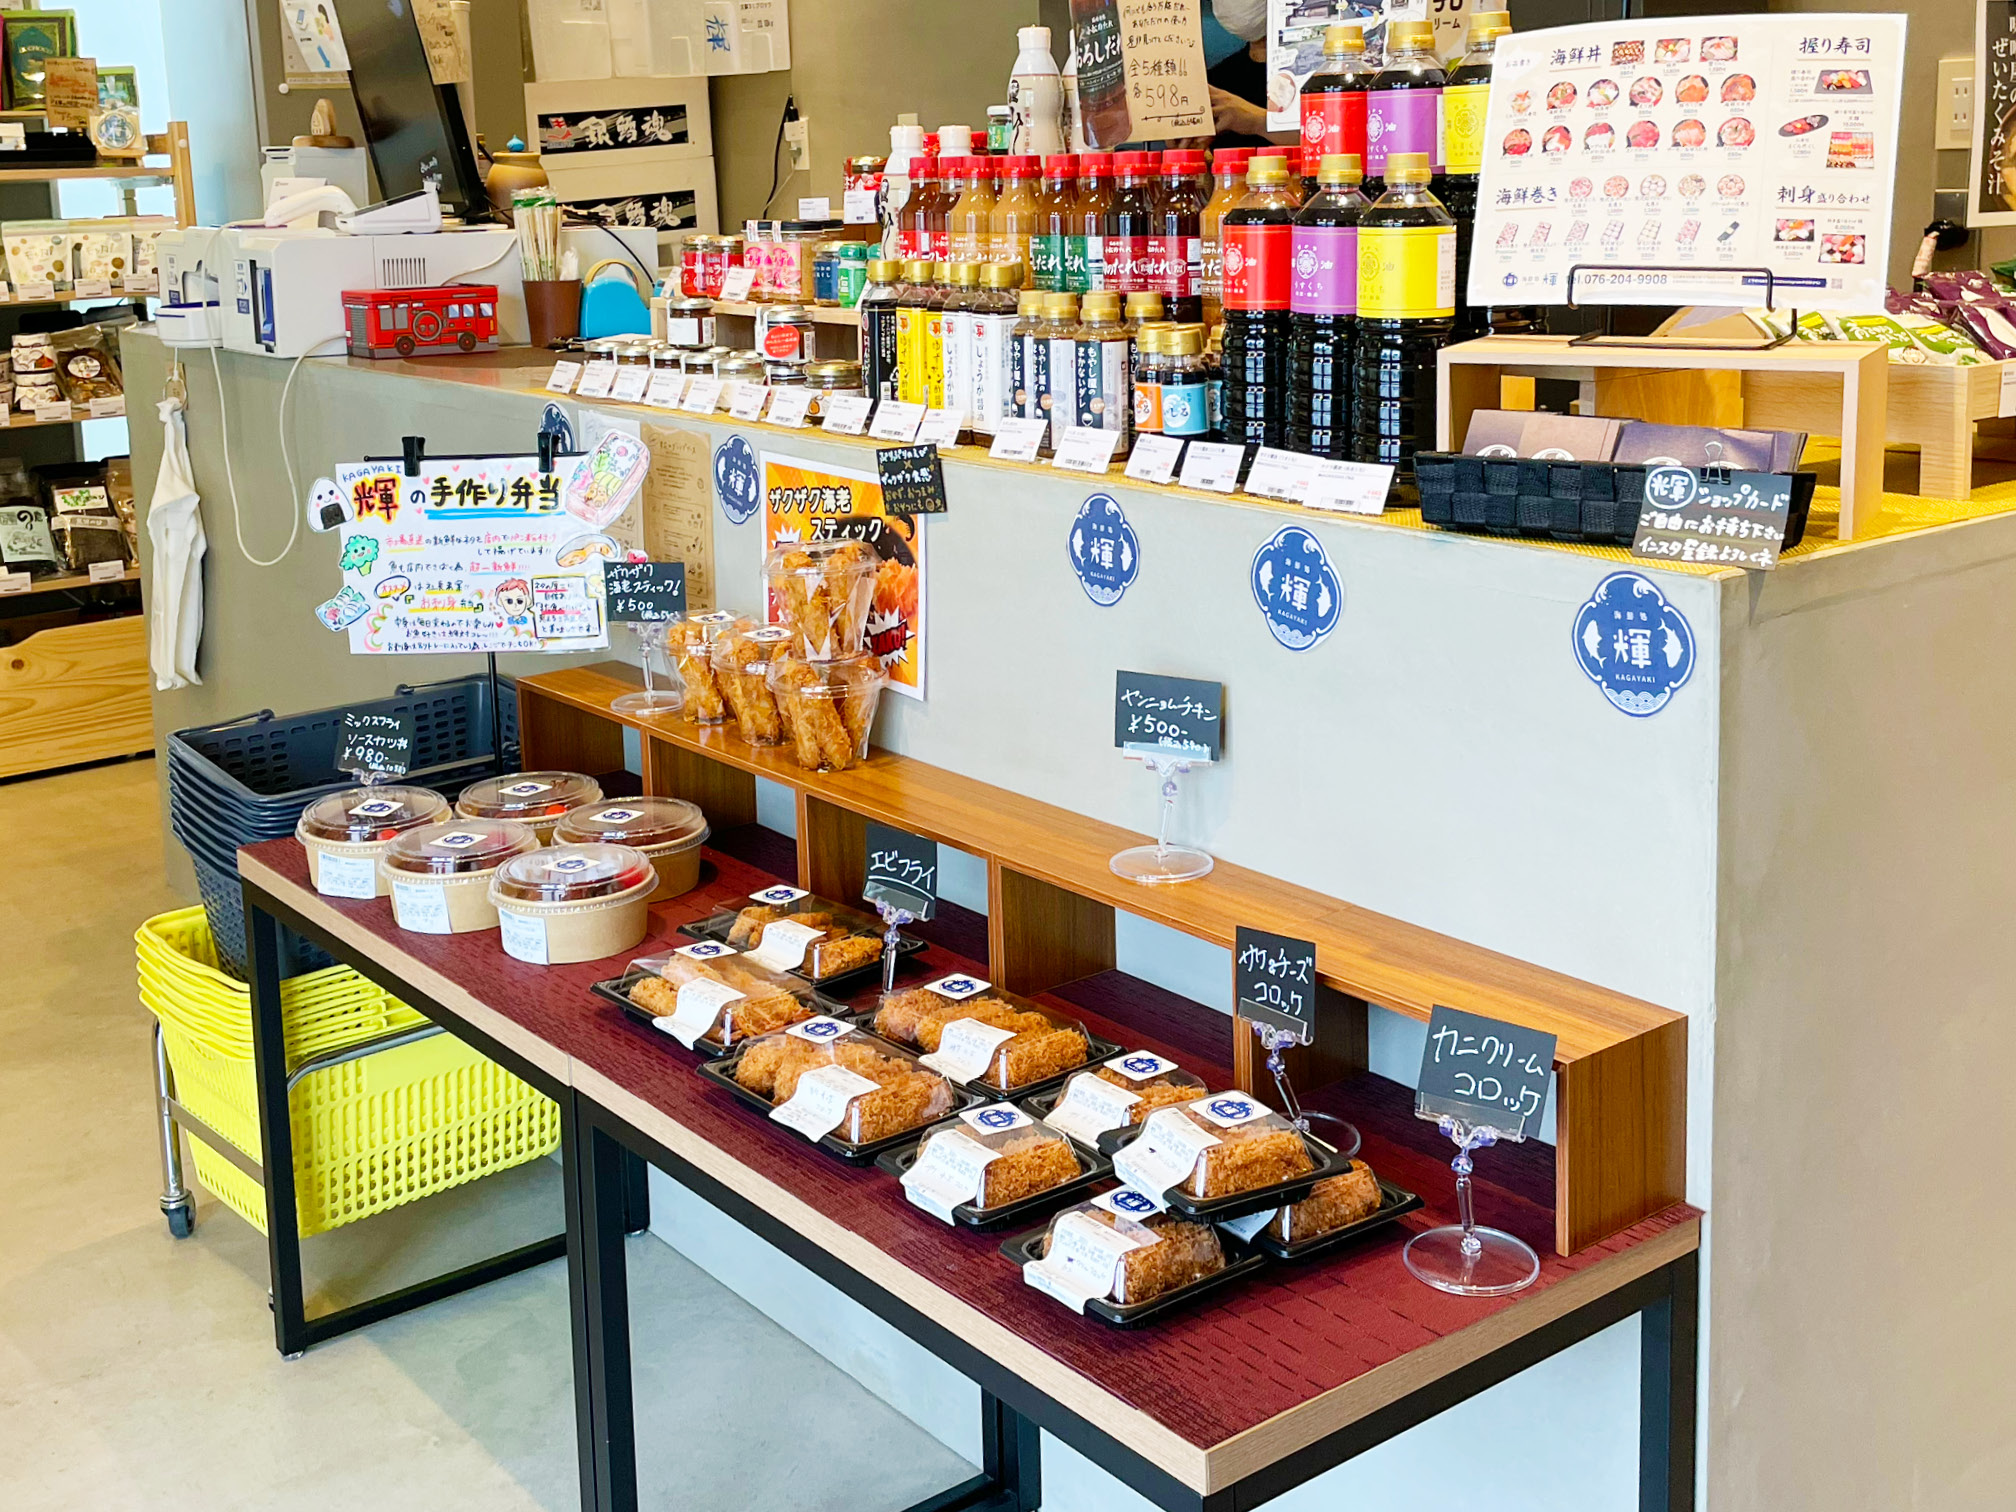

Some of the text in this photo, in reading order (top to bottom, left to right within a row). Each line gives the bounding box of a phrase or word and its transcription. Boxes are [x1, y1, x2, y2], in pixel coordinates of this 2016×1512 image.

[1798, 36, 1871, 55] 握り寿司
[1987, 37, 2009, 196] ぜいたくみそ汁
[1496, 186, 1558, 205] 海鮮巻き
[1077, 347, 1087, 409] まかないダレ
[1087, 347, 1098, 396] もやし屋の
[342, 464, 402, 482] KAGAYAKI
[728, 467, 747, 497] 輝
[354, 474, 560, 521] 輝の手作り弁当
[768, 487, 852, 515] ザクザク海老
[1651, 474, 1790, 511] 輝 ショップカード
[810, 517, 882, 542] スティック
[1639, 510, 1785, 541] ご自由にお持ち下さい
[1090, 537, 1115, 570] 輝
[1638, 536, 1774, 568] インスタ登録よろしくネ
[607, 564, 654, 579] ザクザク
[616, 600, 654, 613] ¥500
[1279, 574, 1312, 611] 輝
[1277, 609, 1309, 626] KAGAYAKI
[1613, 629, 1652, 669] 輝
[1615, 674, 1656, 683] KAGAYAKI
[1121, 689, 1218, 721] ヤンニョムチキン
[344, 713, 401, 730] ミックスフライ
[347, 733, 409, 751] ソースカツ丼
[870, 849, 936, 890] エビフライ
[1238, 943, 1312, 985] サケ&チーズ
[1254, 981, 1303, 1016] コロッケ
[1431, 1024, 1545, 1077] カニクリーム
[1454, 1072, 1542, 1117] コロッケ
